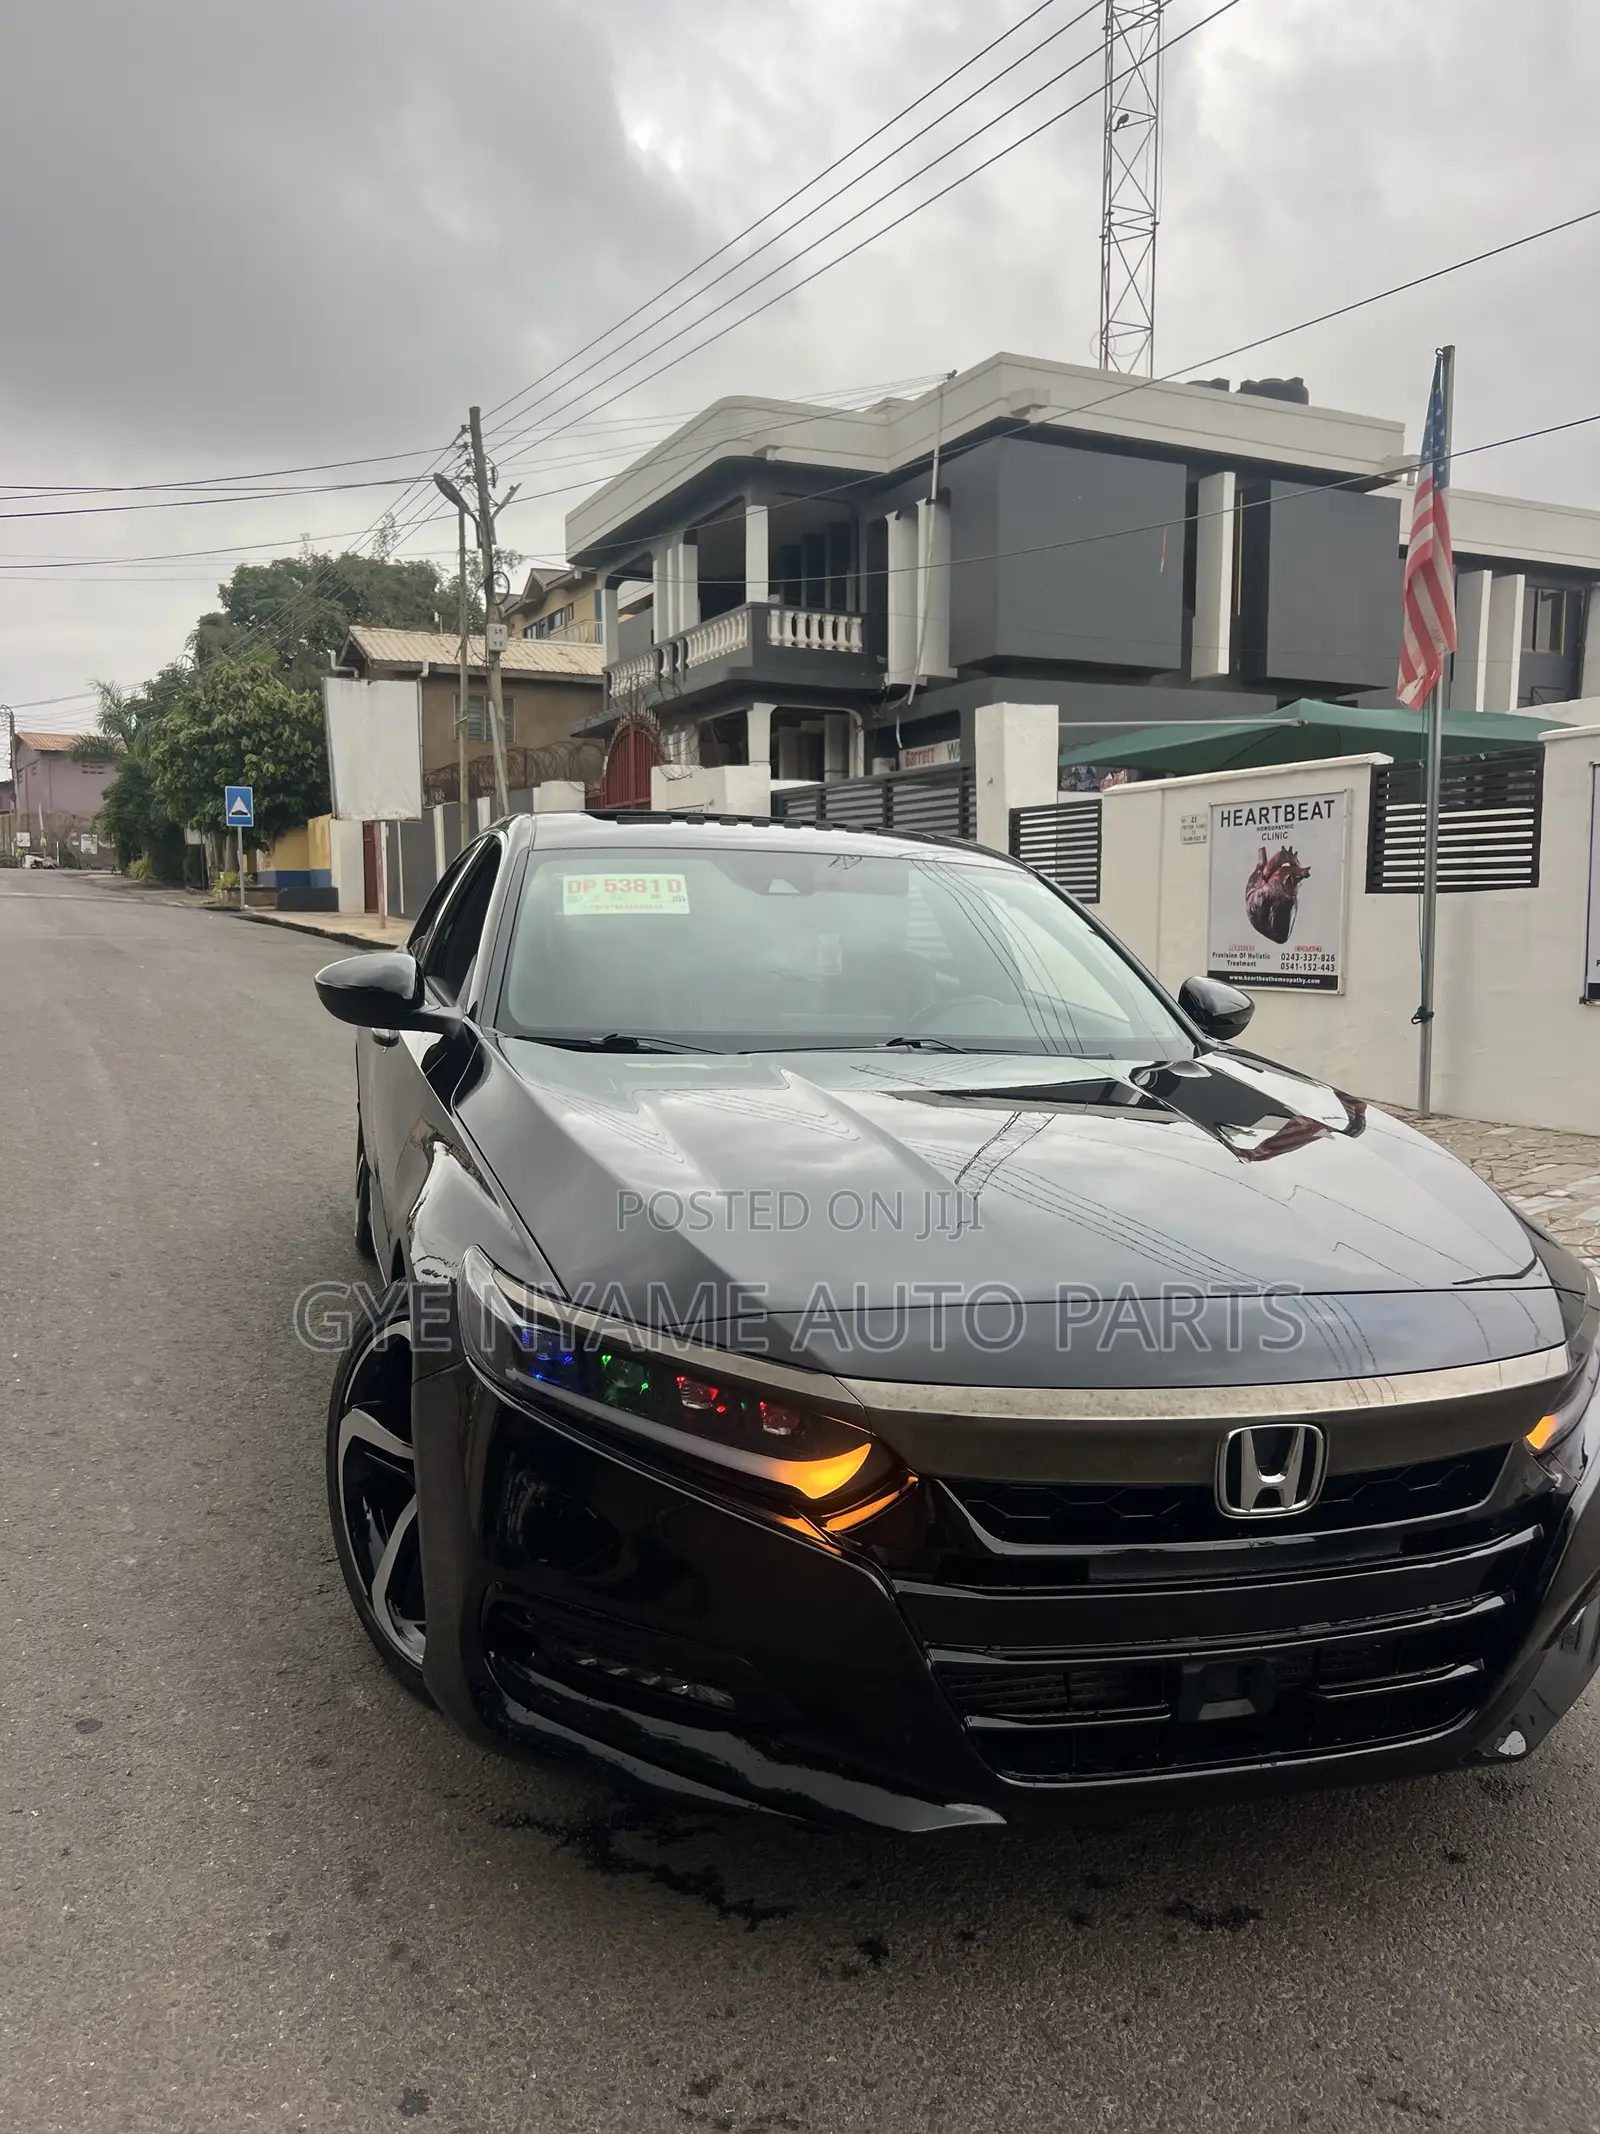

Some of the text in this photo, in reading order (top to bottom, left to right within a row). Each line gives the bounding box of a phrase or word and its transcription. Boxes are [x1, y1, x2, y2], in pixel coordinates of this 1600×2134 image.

[1220, 800, 1335, 828] HEARTBEAT
[1256, 823, 1295, 832] HOMEOPATHIC
[1261, 831, 1289, 841] CLINIC
[567, 879, 597, 894] DP
[604, 878, 661, 893] 5381
[1280, 953, 1336, 962] 0243-337-826
[1280, 962, 1335, 972] 0541-152-443
[1228, 974, 1321, 985] www.heartbeathomeopathy.com
